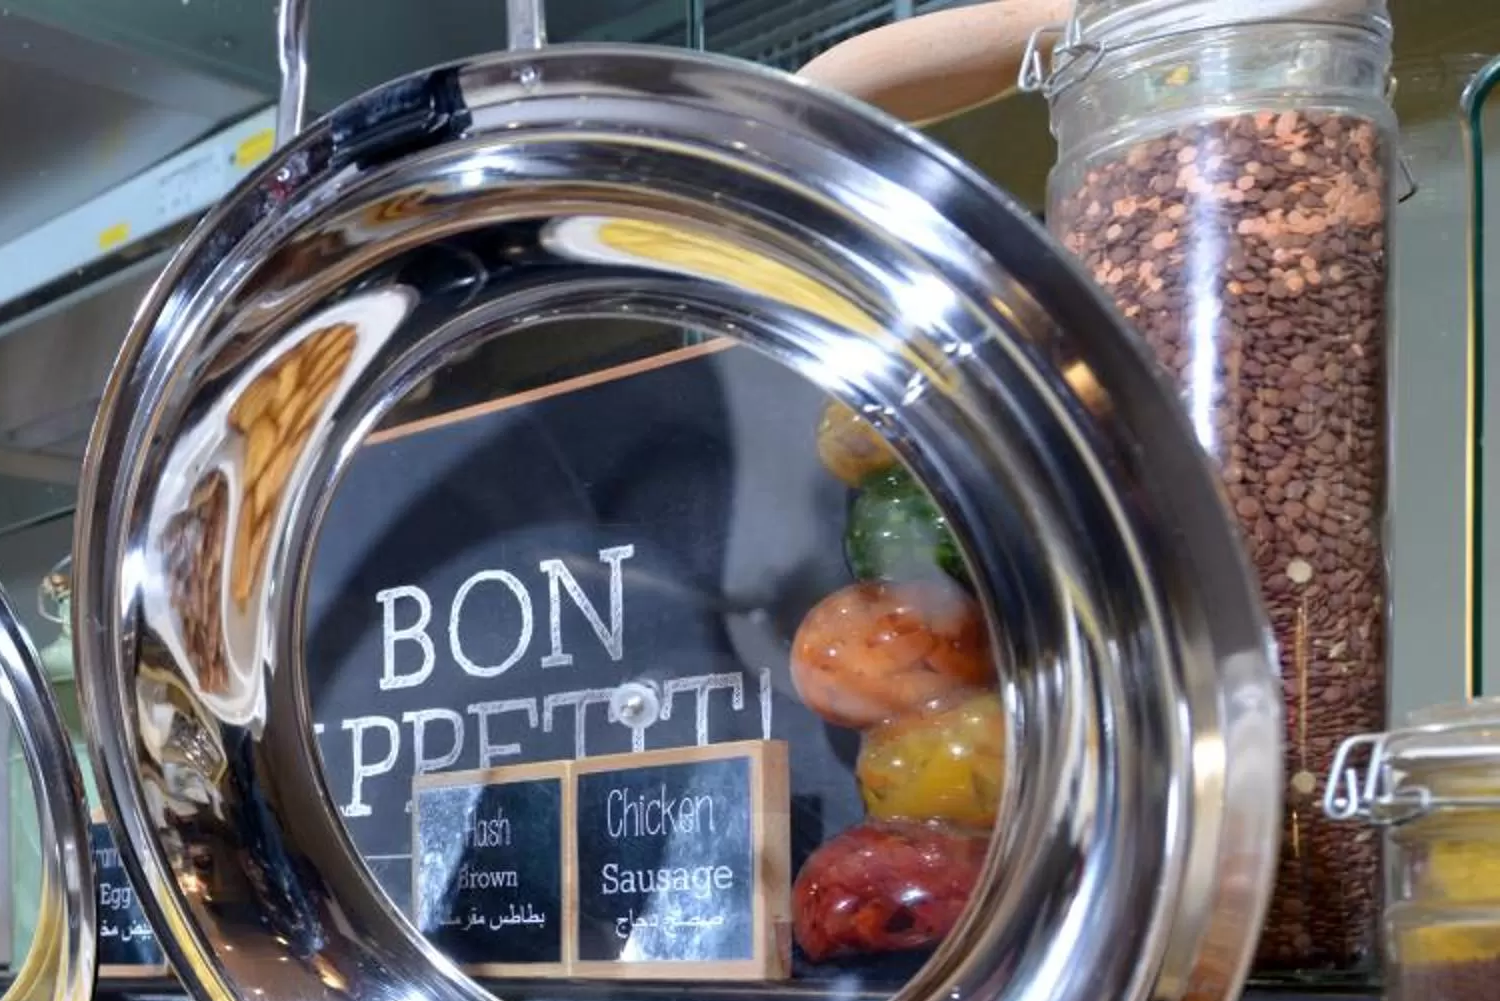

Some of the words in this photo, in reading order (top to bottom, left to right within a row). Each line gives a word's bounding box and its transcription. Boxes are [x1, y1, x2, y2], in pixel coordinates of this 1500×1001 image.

[375, 544, 635, 691] BON
[464, 806, 513, 848] Hash
[606, 783, 716, 838] Chicken
[457, 864, 519, 891] Brown
[601, 863, 734, 900] Sausage
[100, 882, 132, 911] Egg
[489, 902, 546, 931] بطاطس
